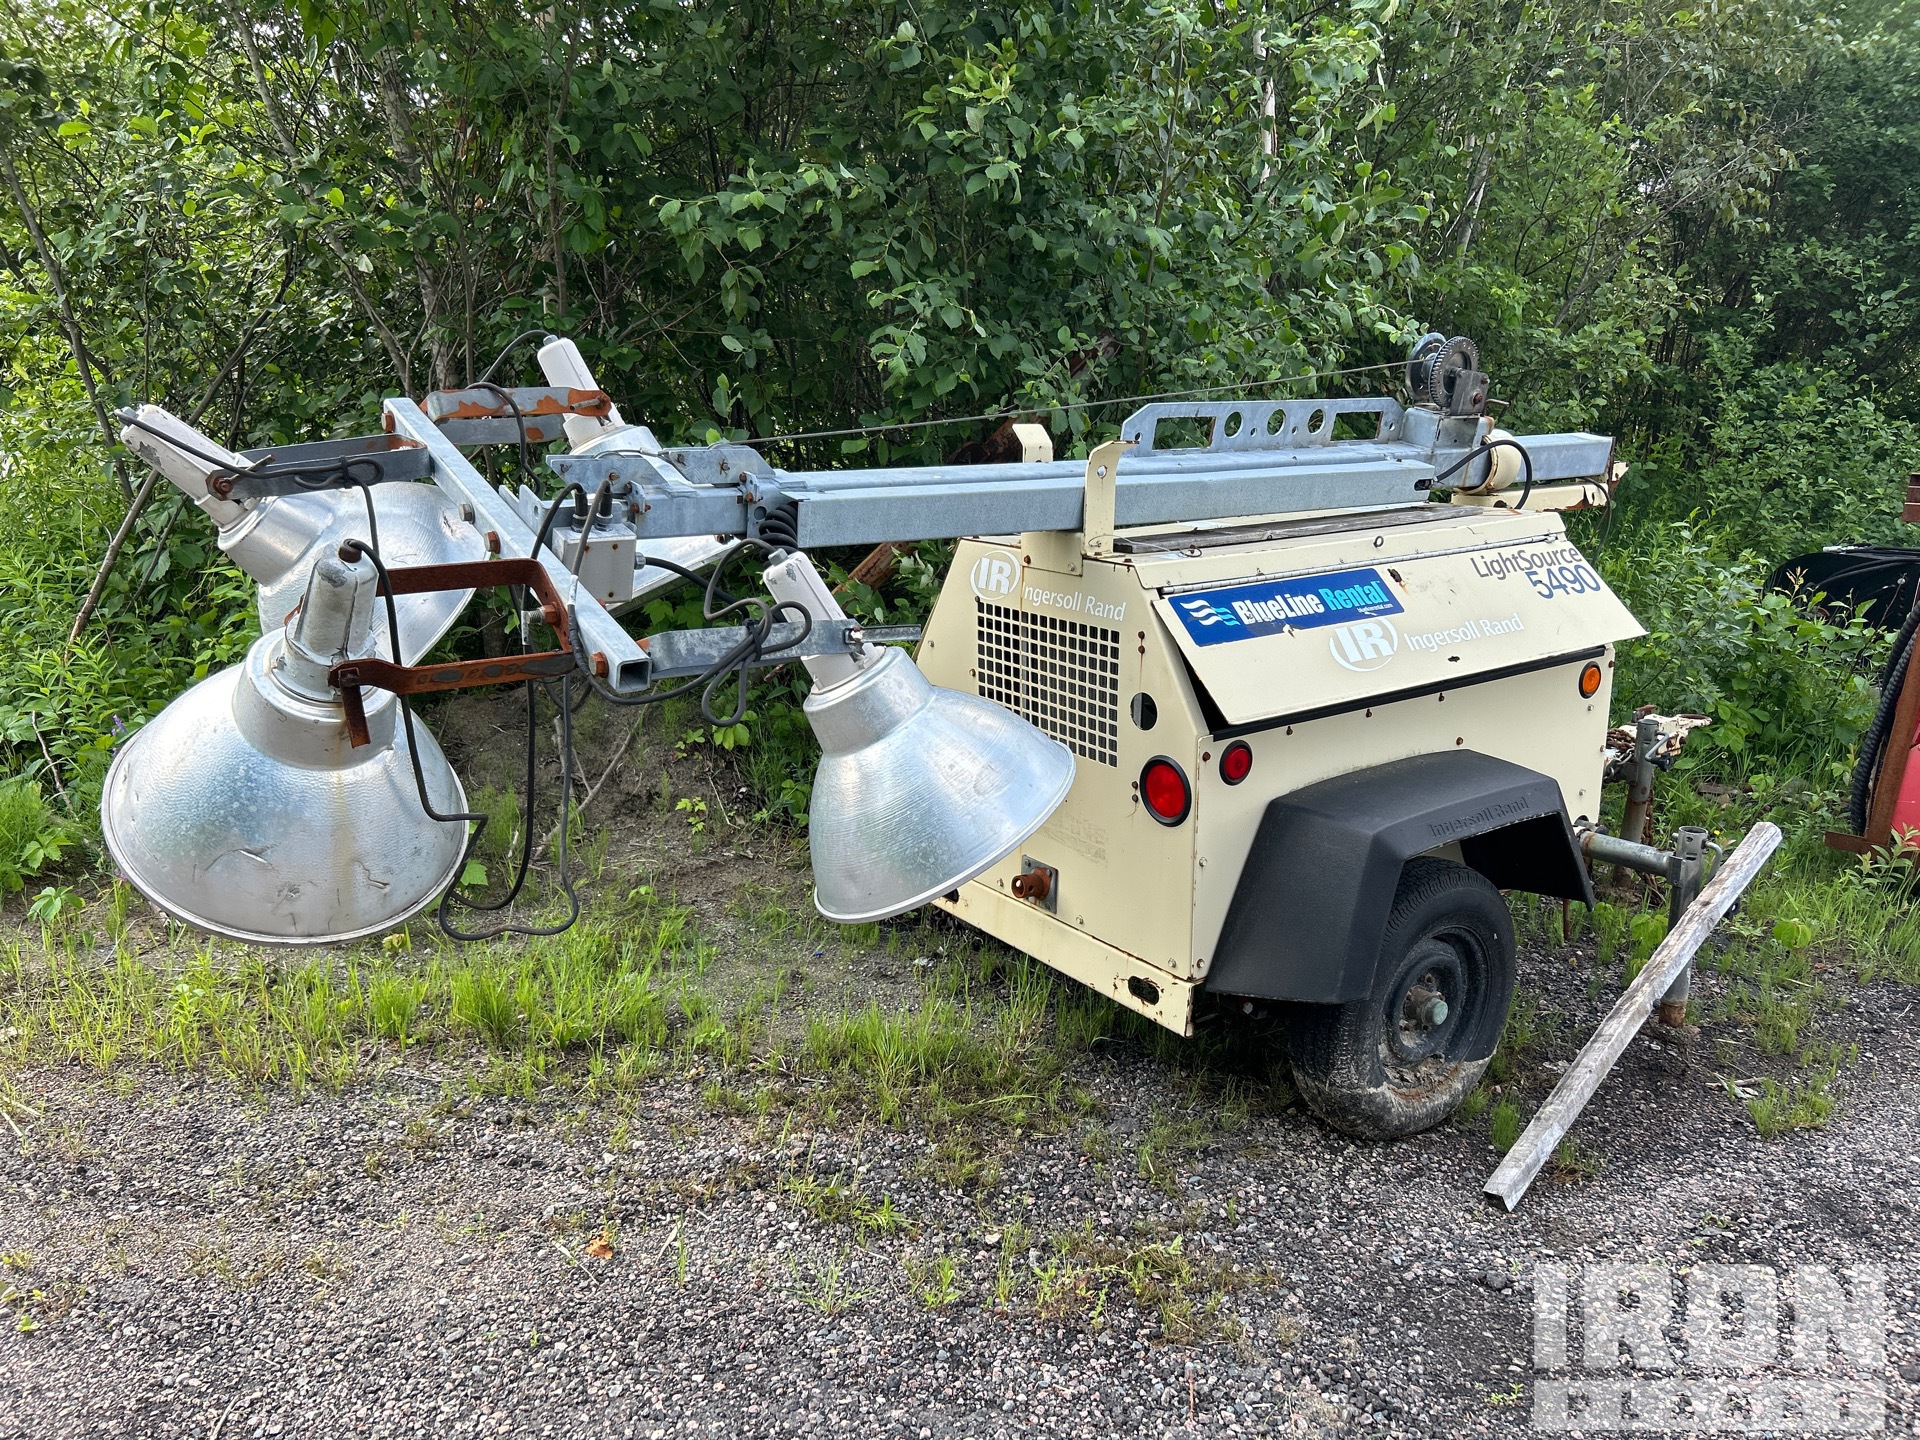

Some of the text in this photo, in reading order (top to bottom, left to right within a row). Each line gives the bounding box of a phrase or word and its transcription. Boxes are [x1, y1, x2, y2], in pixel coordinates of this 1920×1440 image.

[1470, 547, 1583, 581] LightSource
[1525, 564, 1601, 600] 5490
[978, 557, 1012, 595] IR
[1085, 595, 1127, 622] Rand
[1231, 580, 1391, 626] BlueLine Rental
[1334, 612, 1526, 663] IR Ingersoll Rand
[1428, 796, 1530, 838] Ingersoll Rand
